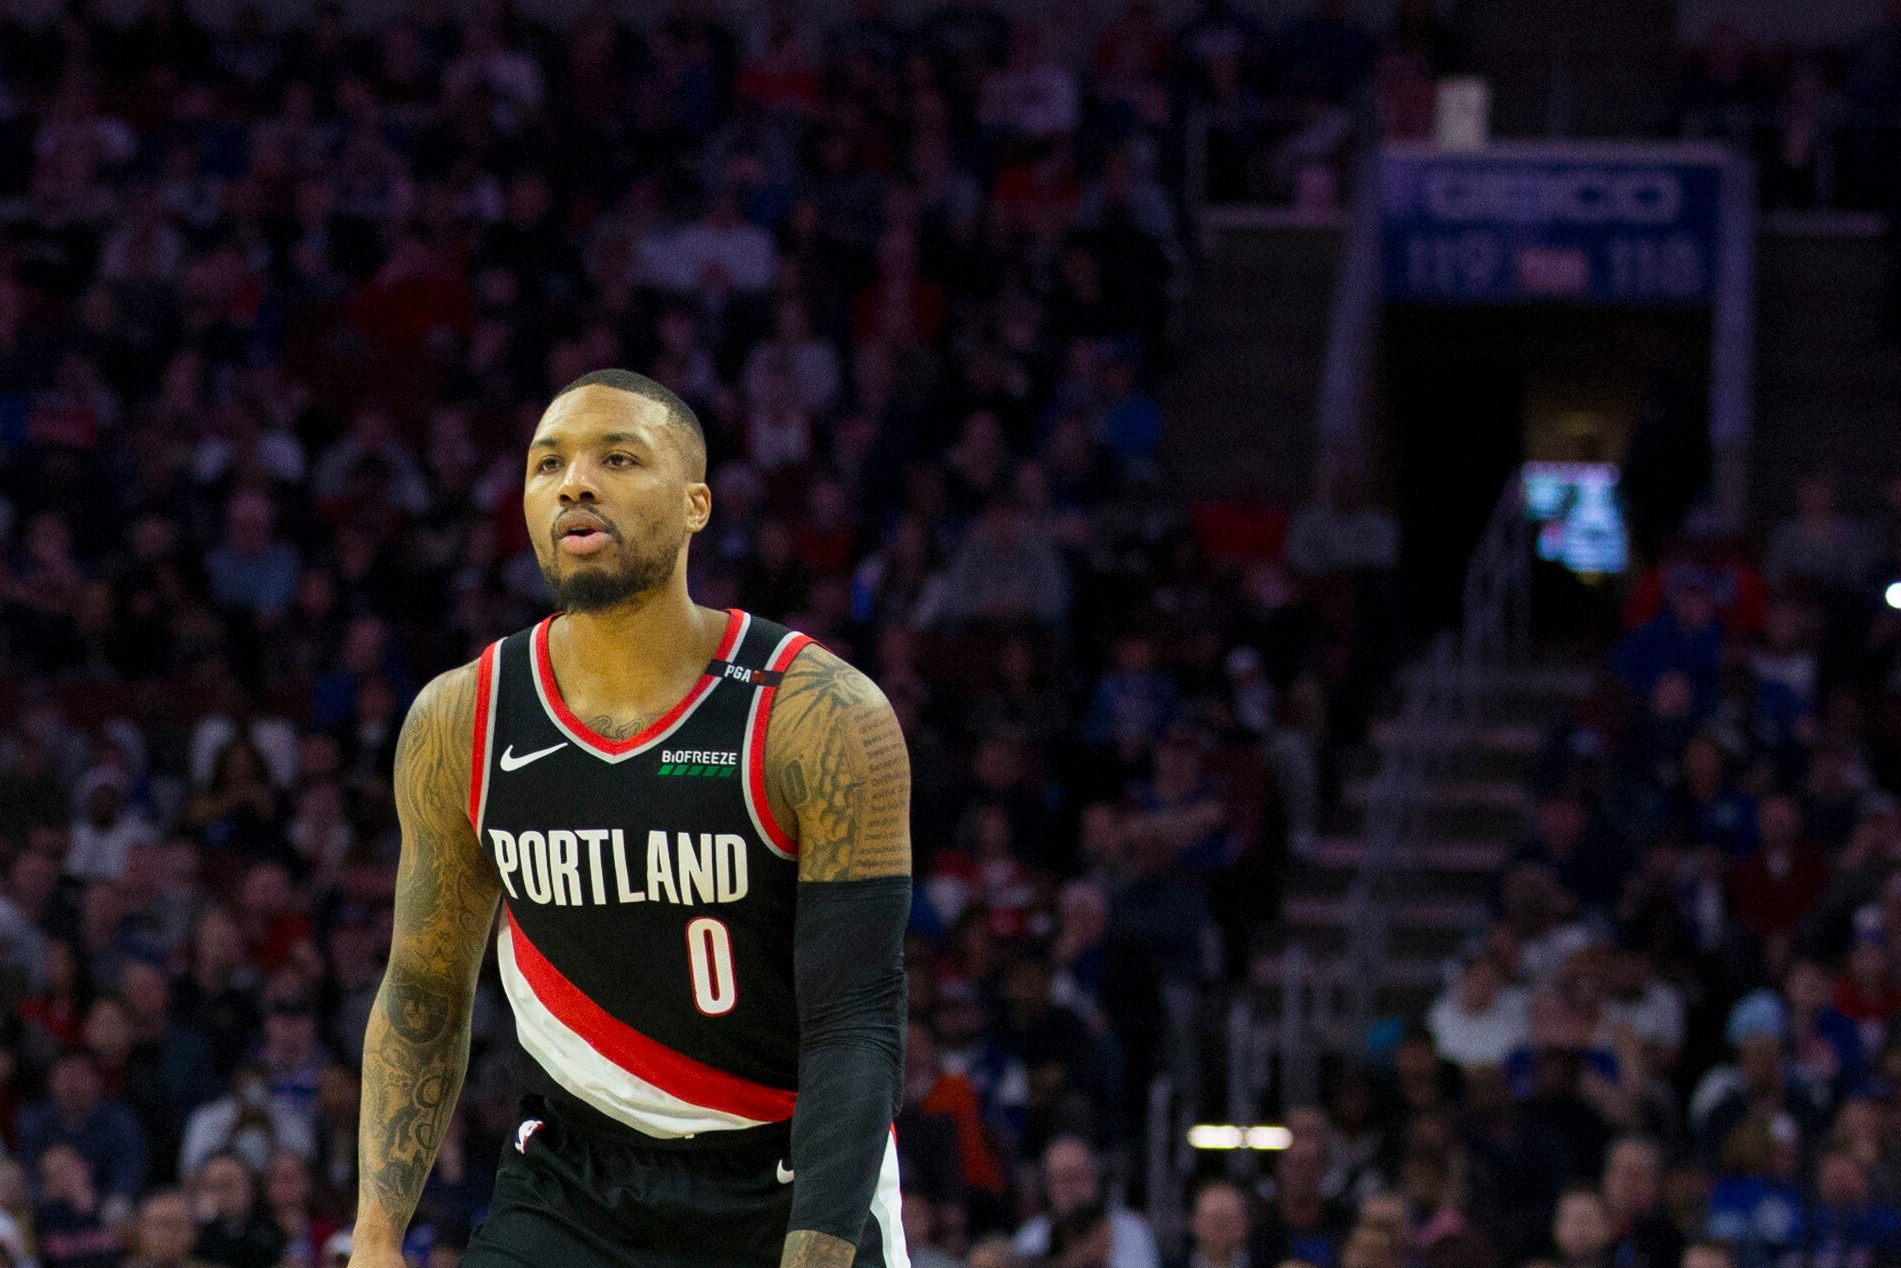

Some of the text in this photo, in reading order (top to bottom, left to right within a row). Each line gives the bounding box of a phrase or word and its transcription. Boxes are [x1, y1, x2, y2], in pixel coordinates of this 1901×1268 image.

[724, 664, 752, 683] PGA
[487, 828, 749, 907] PORTLAND
[685, 915, 739, 1018] 0
